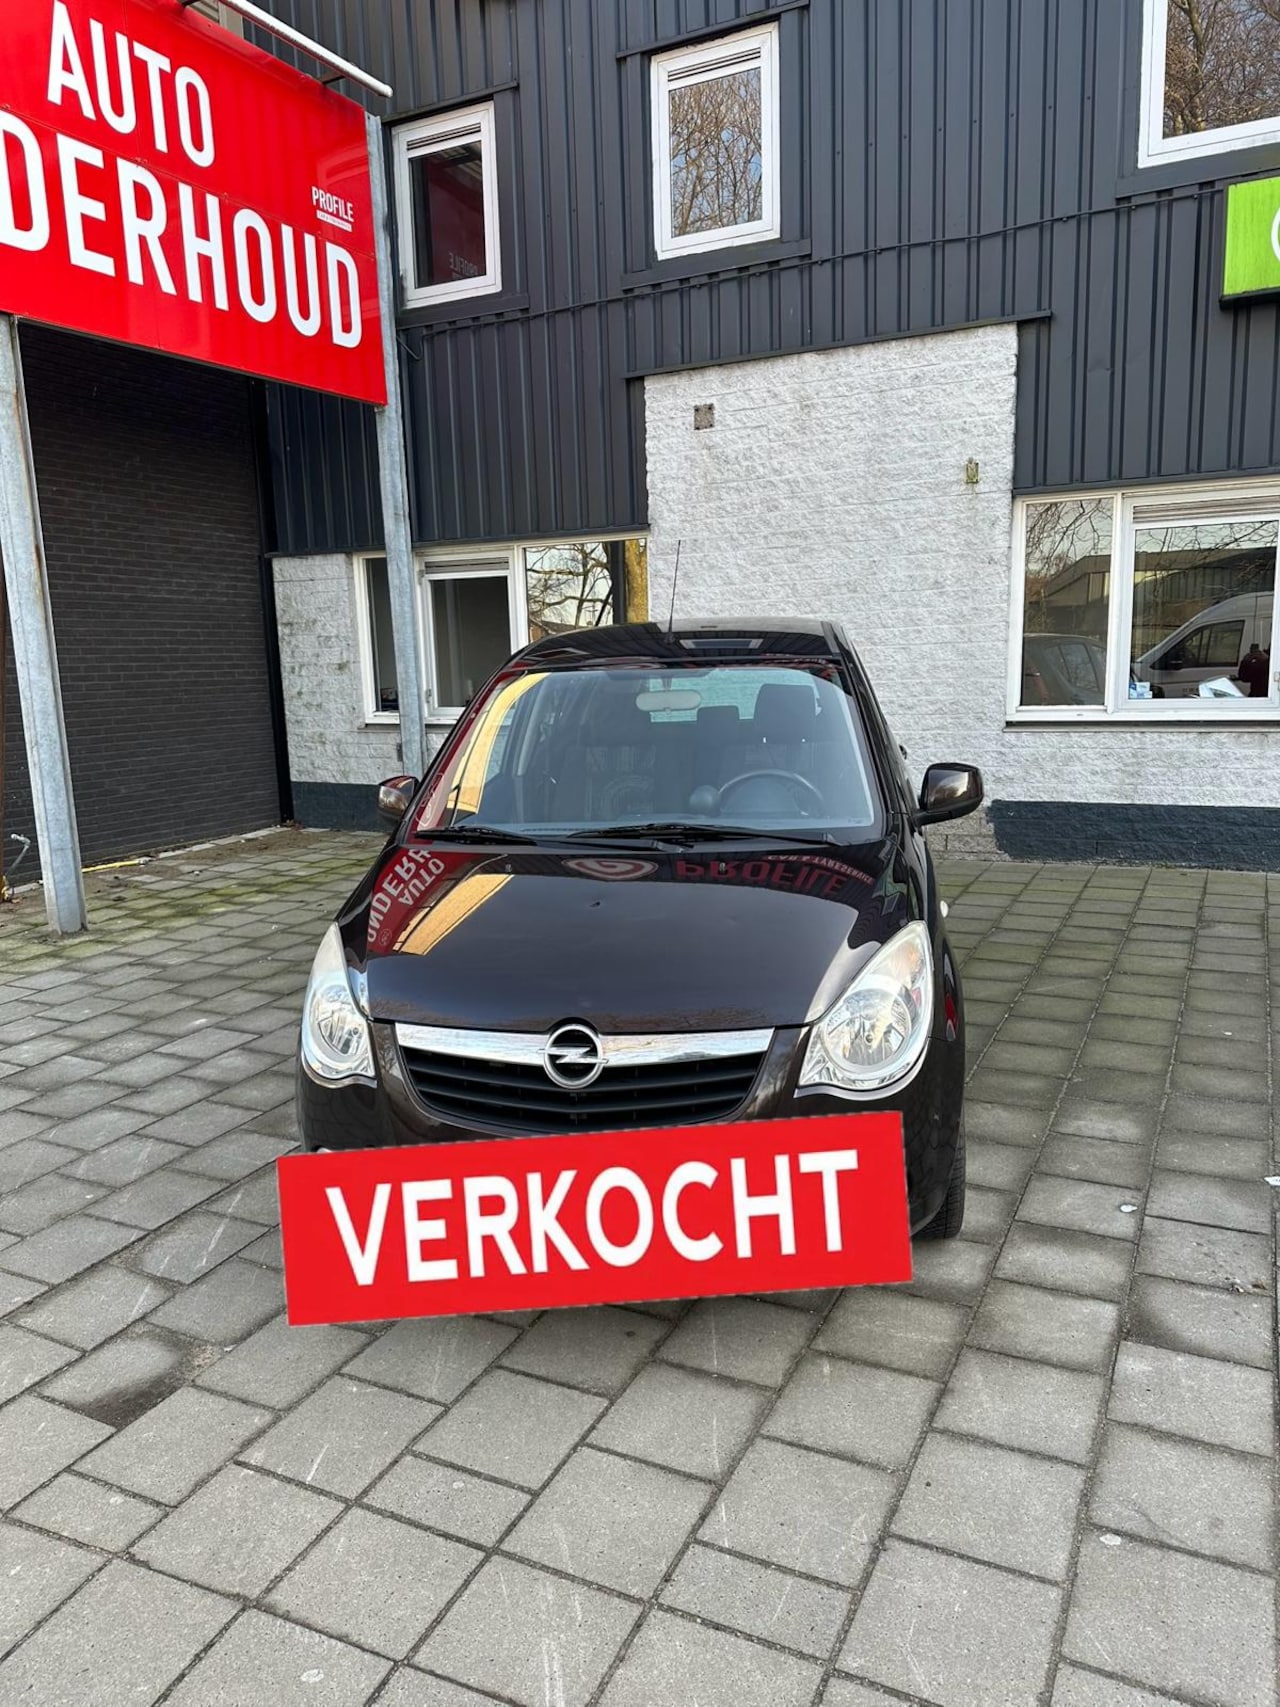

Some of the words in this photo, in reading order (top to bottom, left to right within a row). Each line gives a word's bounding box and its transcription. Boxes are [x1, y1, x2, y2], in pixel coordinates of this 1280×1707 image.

[47, 0, 215, 168] AUTO
[0, 109, 362, 349] DERHOUD
[312, 185, 354, 222] PROFILE
